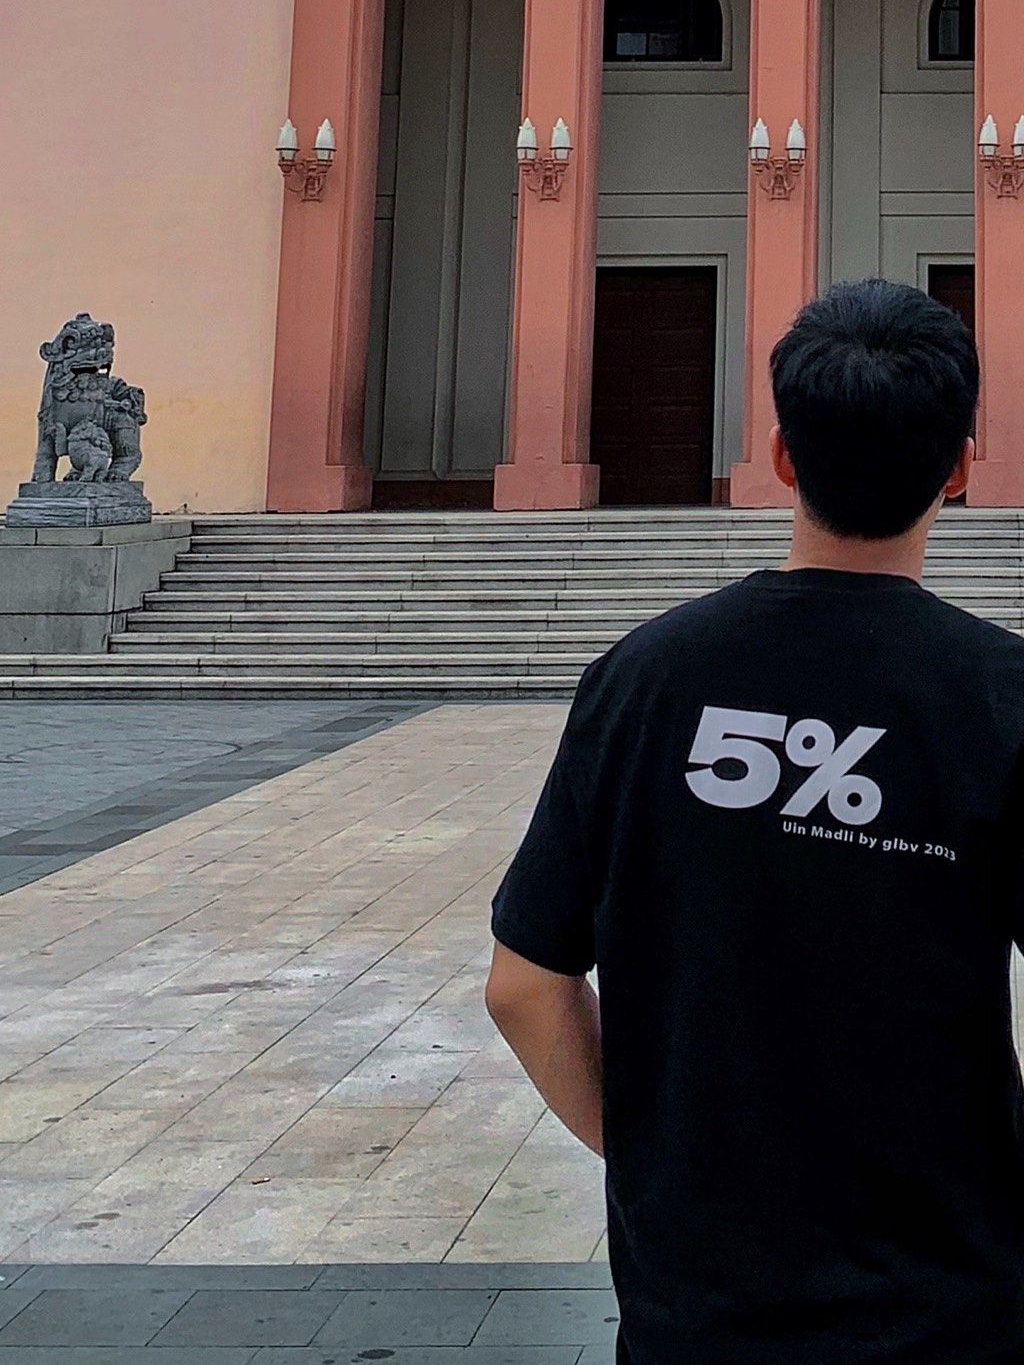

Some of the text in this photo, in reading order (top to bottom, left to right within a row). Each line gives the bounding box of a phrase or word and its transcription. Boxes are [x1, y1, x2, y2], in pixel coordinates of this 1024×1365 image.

[684, 705, 888, 826] 5%
[782, 820, 807, 836] Uin
[810, 824, 854, 843] Madli
[858, 832, 878, 849] by
